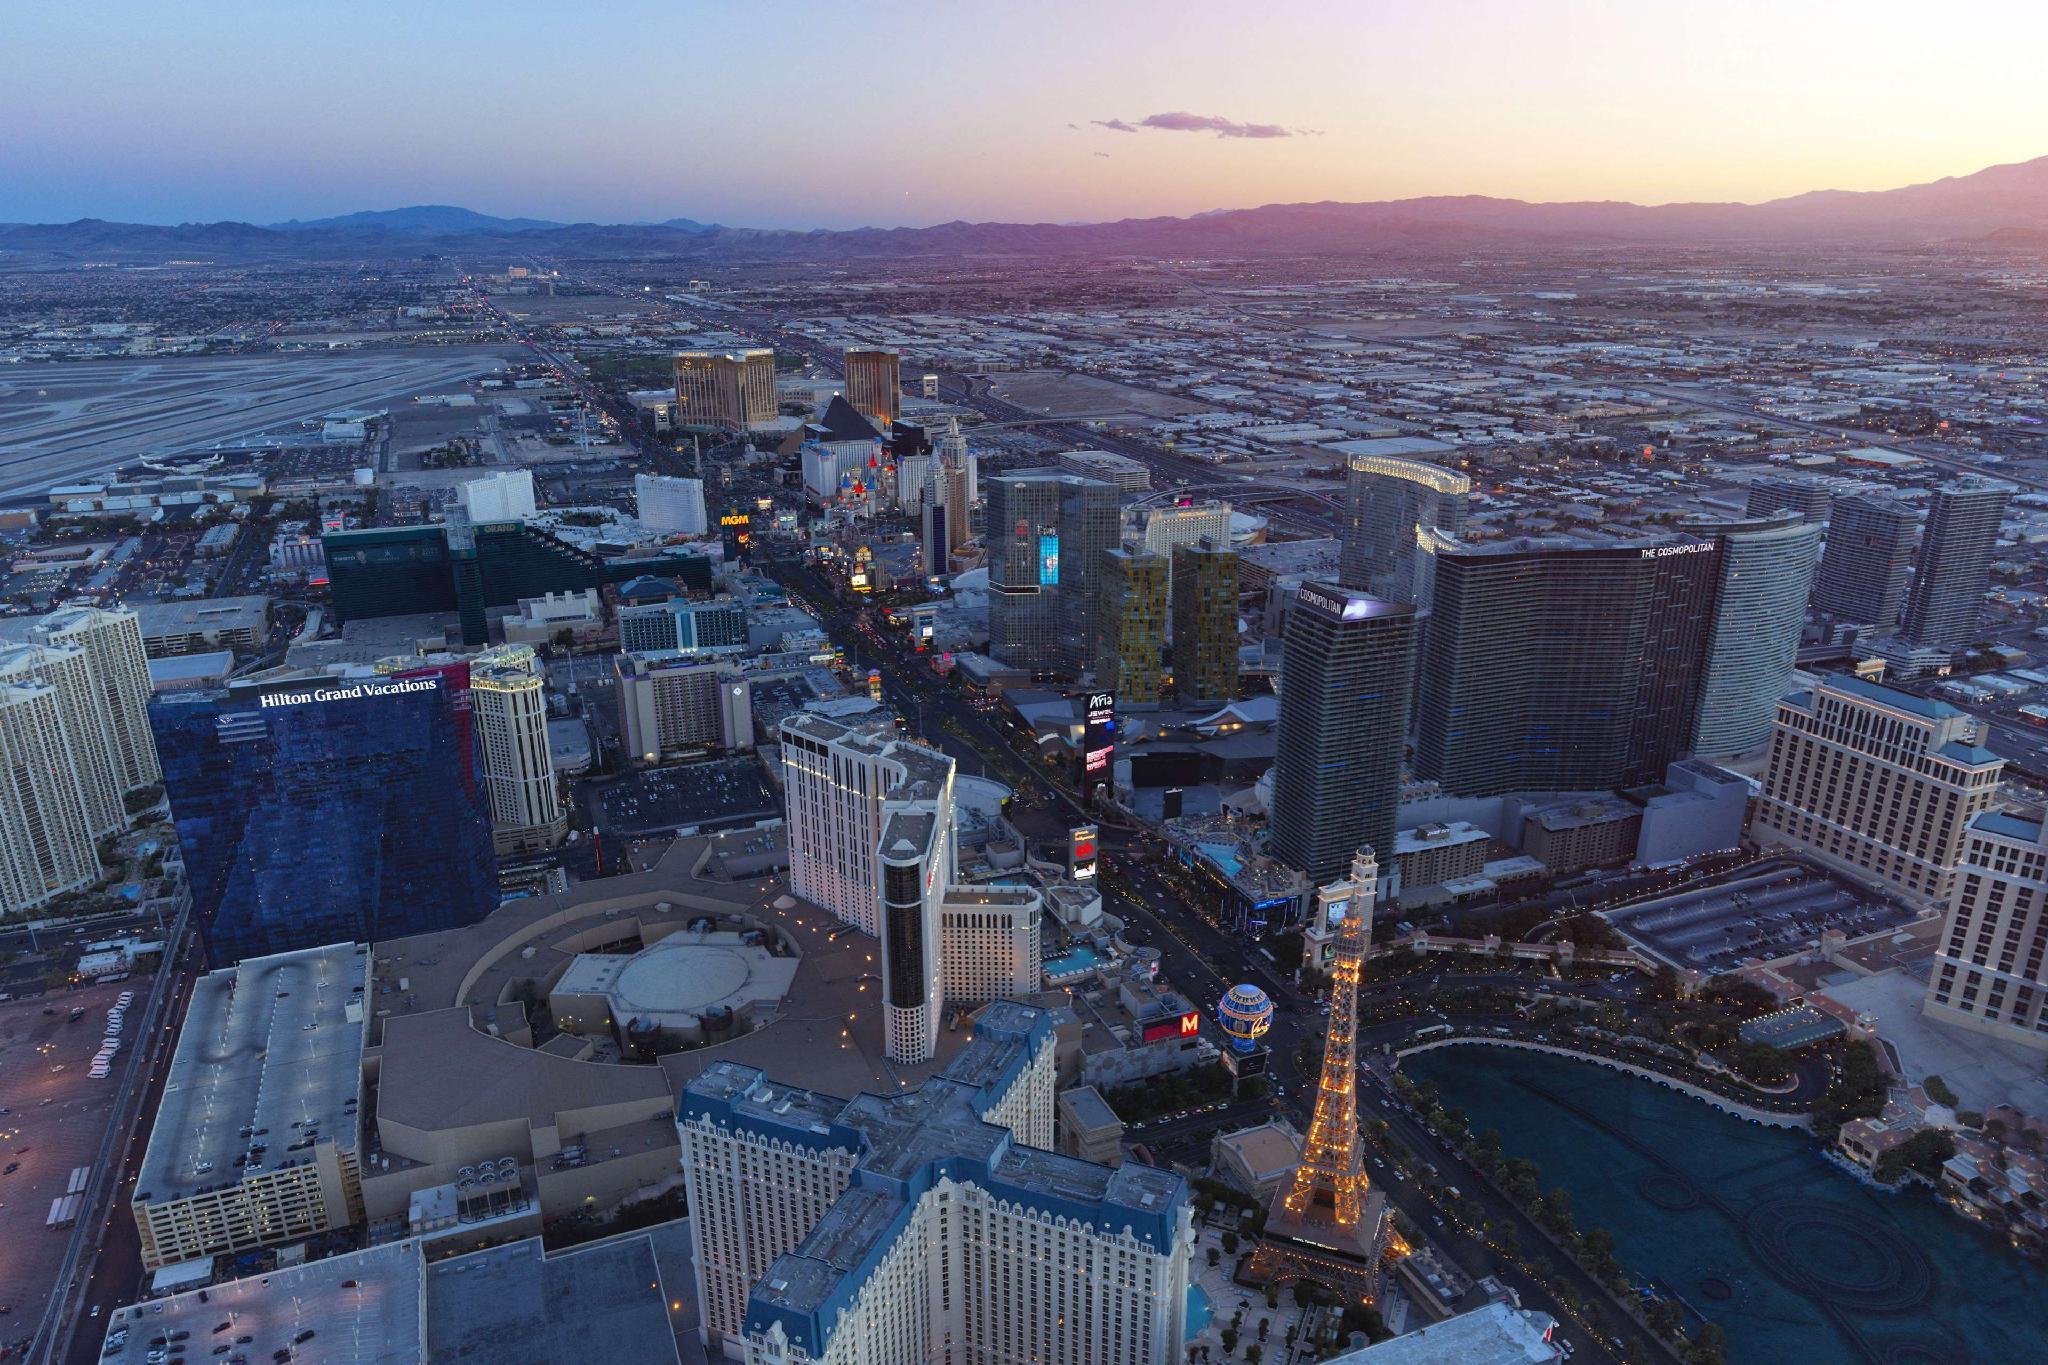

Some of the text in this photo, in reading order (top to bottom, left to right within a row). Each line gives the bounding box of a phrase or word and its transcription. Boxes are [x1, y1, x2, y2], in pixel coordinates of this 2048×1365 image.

[484, 523, 516, 533] GRAND
[721, 516, 749, 525] MGM
[1641, 542, 1715, 558] THE COSMOPOLITAN
[1300, 588, 1341, 614] COSMOPOLITAN
[260, 679, 436, 708] Hilton Grand Vacations
[1089, 694, 1113, 709] Aria
[1088, 709, 1114, 717] JEWEL
[1182, 1015, 1198, 1032] M
[1252, 1016, 1270, 1039] Paris
